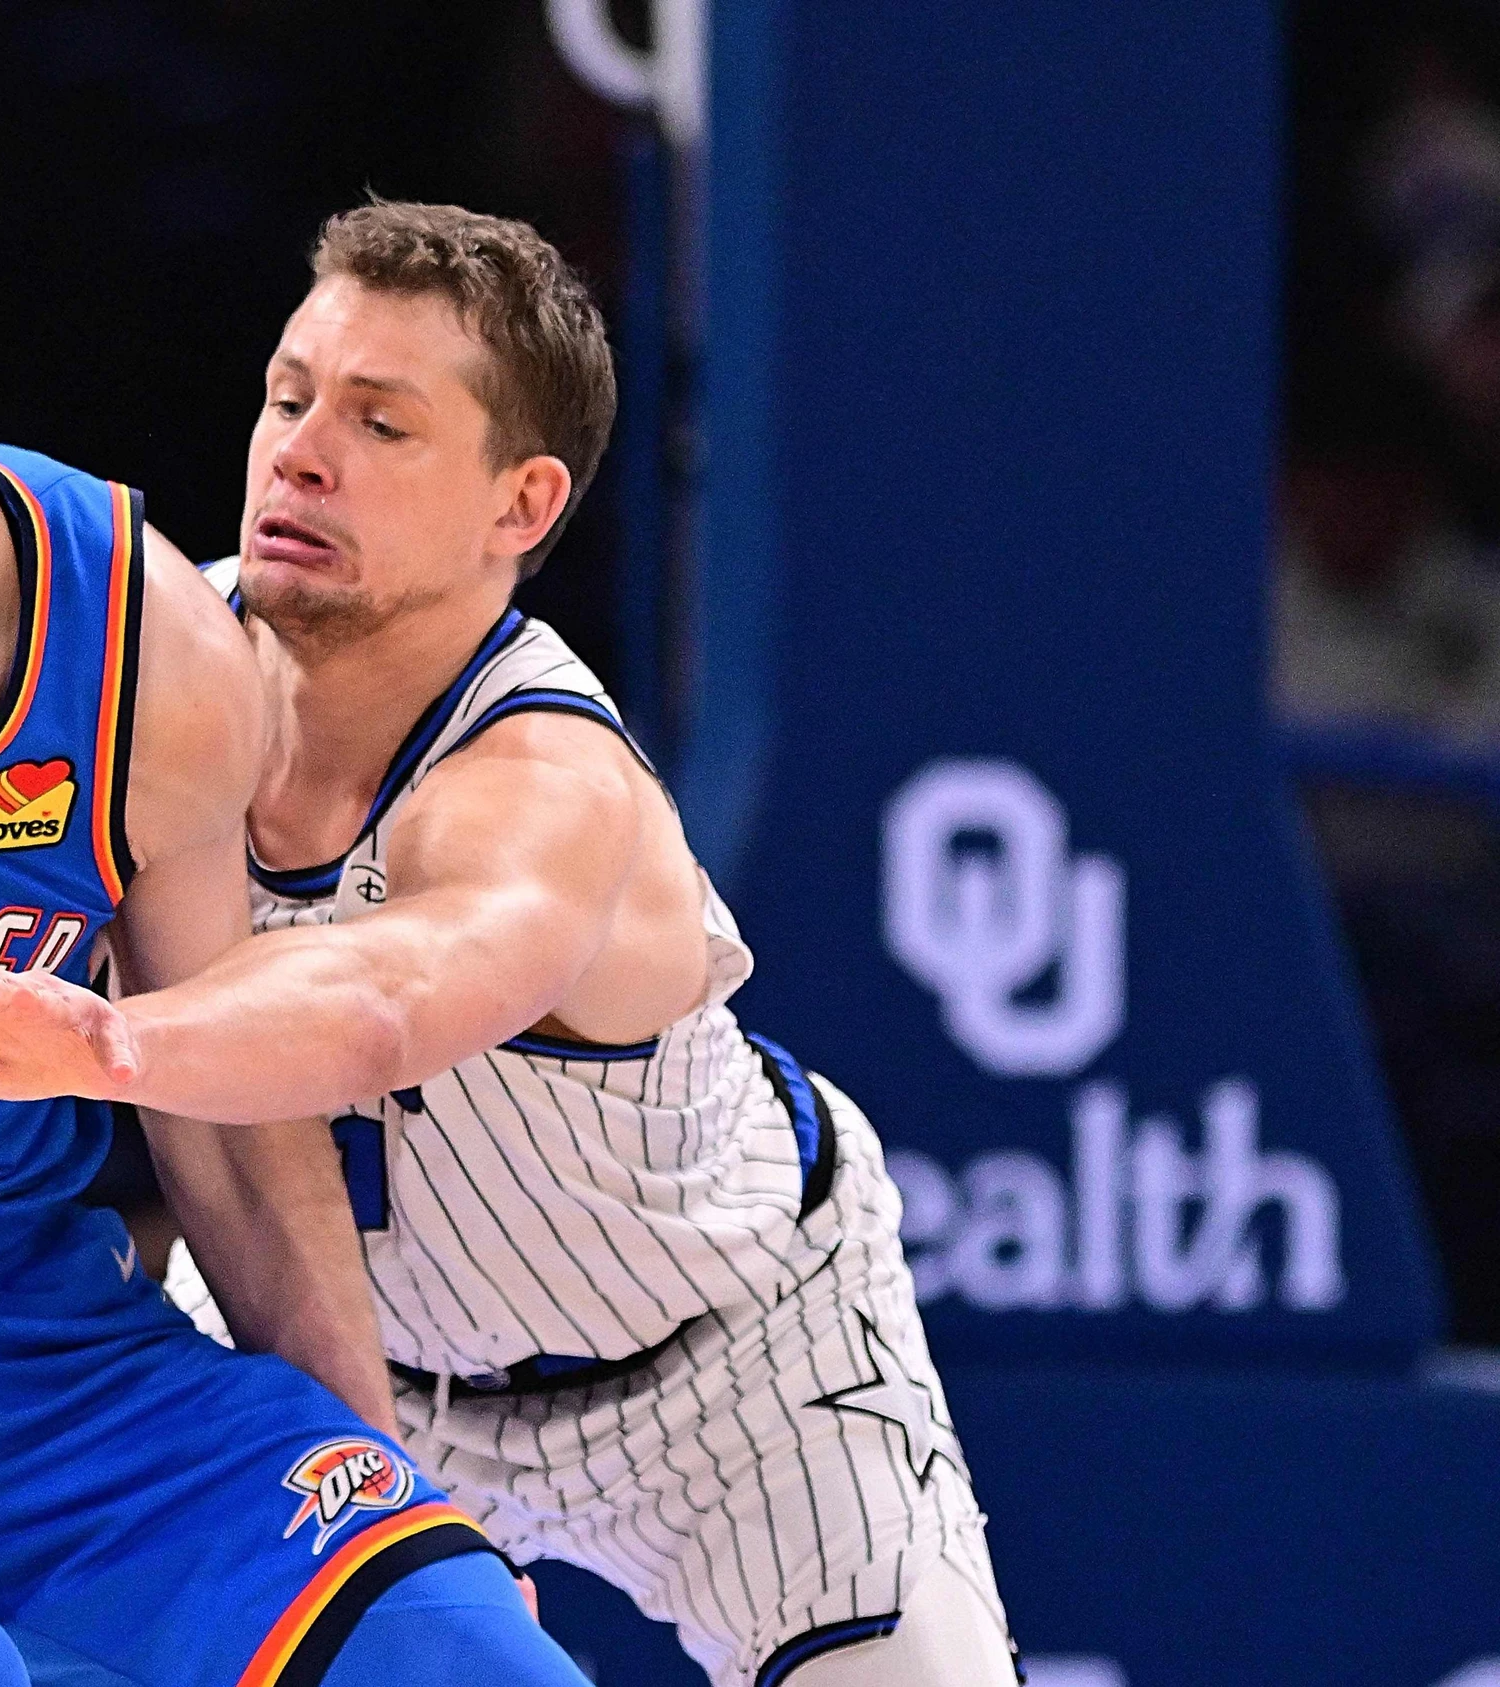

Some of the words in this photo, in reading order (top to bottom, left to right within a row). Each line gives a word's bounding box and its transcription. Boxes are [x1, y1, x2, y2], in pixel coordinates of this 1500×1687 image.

[884, 758, 1127, 1076] OU
[886, 1080, 1346, 1312] ealth
[319, 1449, 385, 1523] OKC
